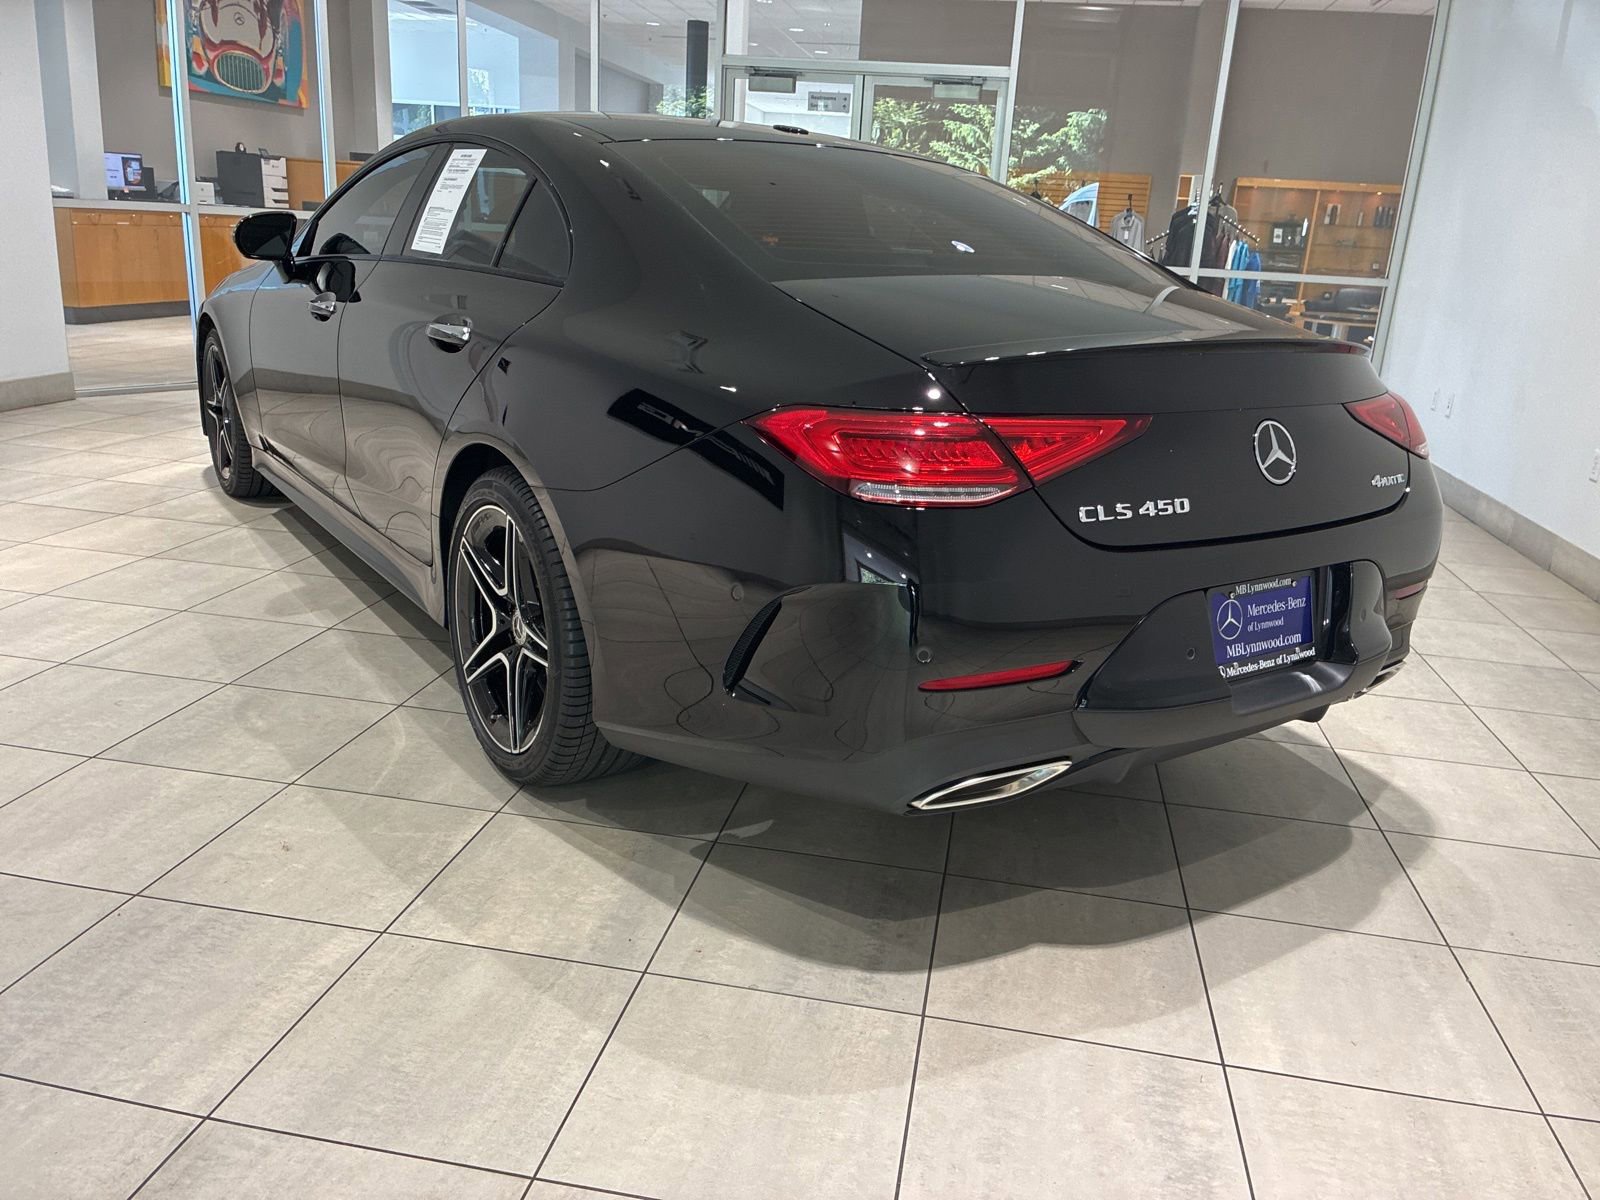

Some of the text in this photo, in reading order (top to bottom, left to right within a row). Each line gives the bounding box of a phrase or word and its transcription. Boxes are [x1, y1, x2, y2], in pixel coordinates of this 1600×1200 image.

[1079, 498, 1190, 523] CLS 450
[1247, 597, 1306, 618] Mercedes-Benz
[1247, 616, 1284, 633] of Lynnwood
[1226, 633, 1302, 659] MBLynnwood.com
[1226, 646, 1316, 678] Mercedes-Benz of Lynnwood
